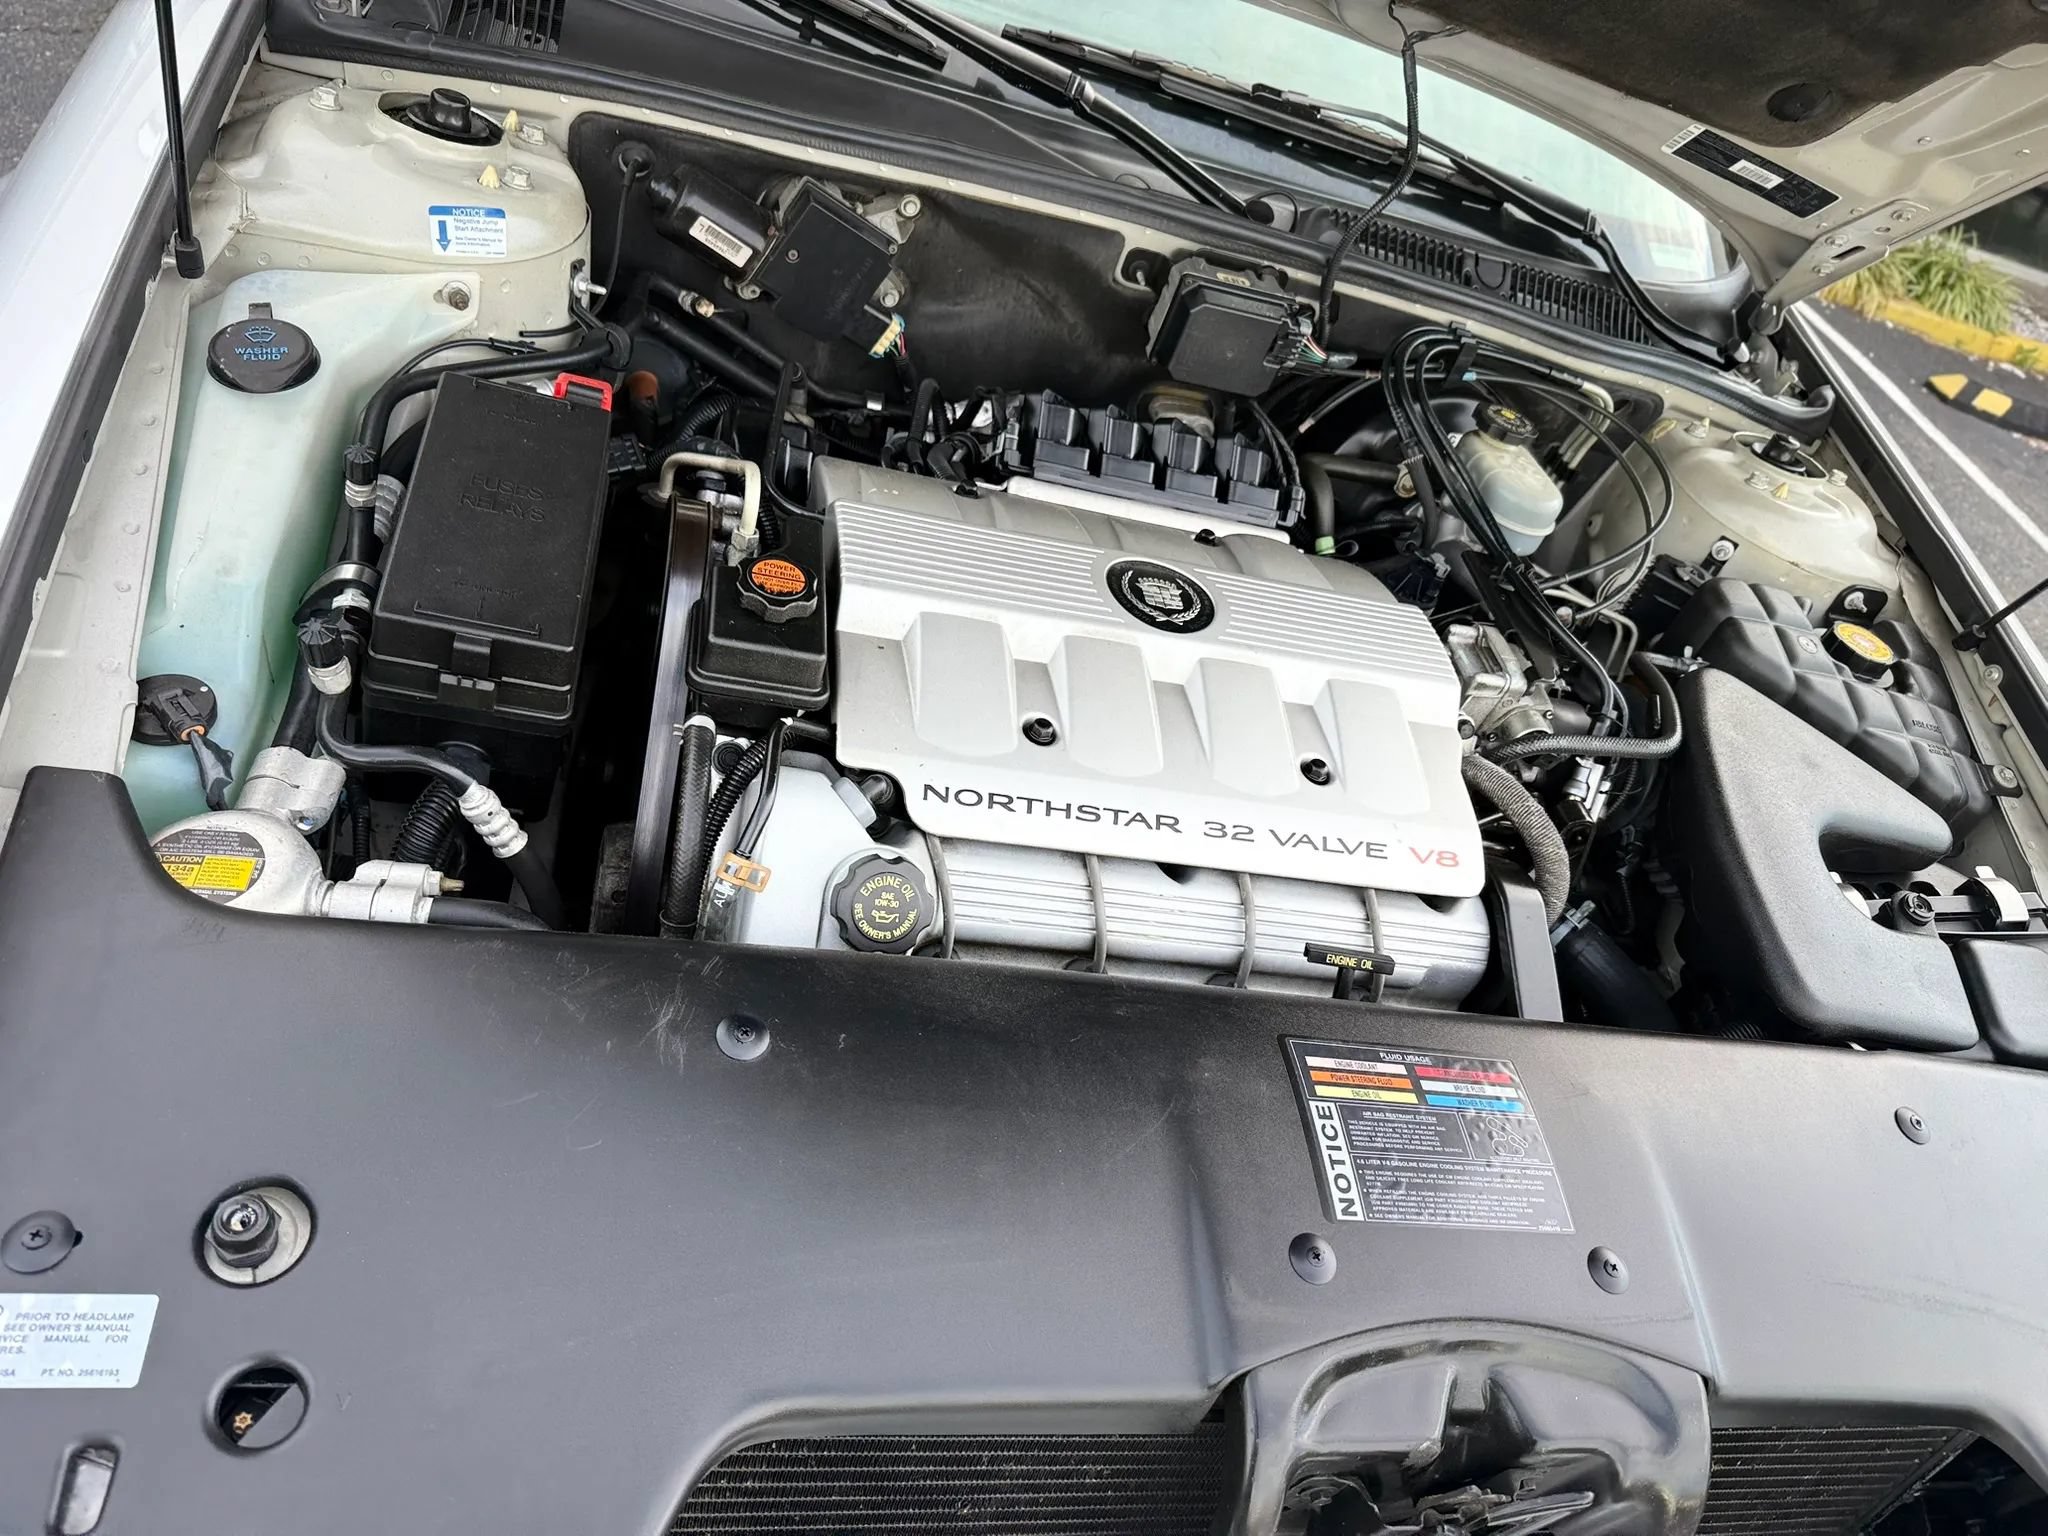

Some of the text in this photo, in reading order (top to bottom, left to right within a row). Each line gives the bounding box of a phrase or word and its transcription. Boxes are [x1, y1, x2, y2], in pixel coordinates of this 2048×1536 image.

[452, 208, 486, 217] NOTICE
[469, 472, 544, 501] FUSES
[459, 492, 545, 522] RELAYS
[763, 561, 796, 572] POWER
[757, 567, 801, 580] STEERING
[923, 783, 1459, 867] NORTHSTAR 32 VALVE V8
[163, 855, 202, 863] CAUTION
[860, 875, 916, 902] ENGINE OIL
[881, 892, 895, 900] SAE
[874, 898, 899, 908] 10W-30
[854, 903, 917, 940] SEE OWNER'S MANUAL
[1326, 954, 1374, 971] ENGINE OIL
[1379, 1052, 1431, 1063] FLUID USAGE
[1335, 1060, 1378, 1070] ENGINE COOLANT
[1330, 1073, 1393, 1085] POWER STEERING FLUID
[1351, 1089, 1382, 1099] ENGINE OIL
[1315, 1105, 1358, 1217] NOTICE
[1391, 1160, 1418, 1168] GASOLINE
[16, 1312, 135, 1321] PRIOR TO HEADLAMP
[3, 1323, 131, 1332] SEE OWNER'S MANUAL
[43, 1334, 90, 1343] MANUAL
[105, 1334, 129, 1343] FOR
[57, 1368, 73, 1376] NO.
